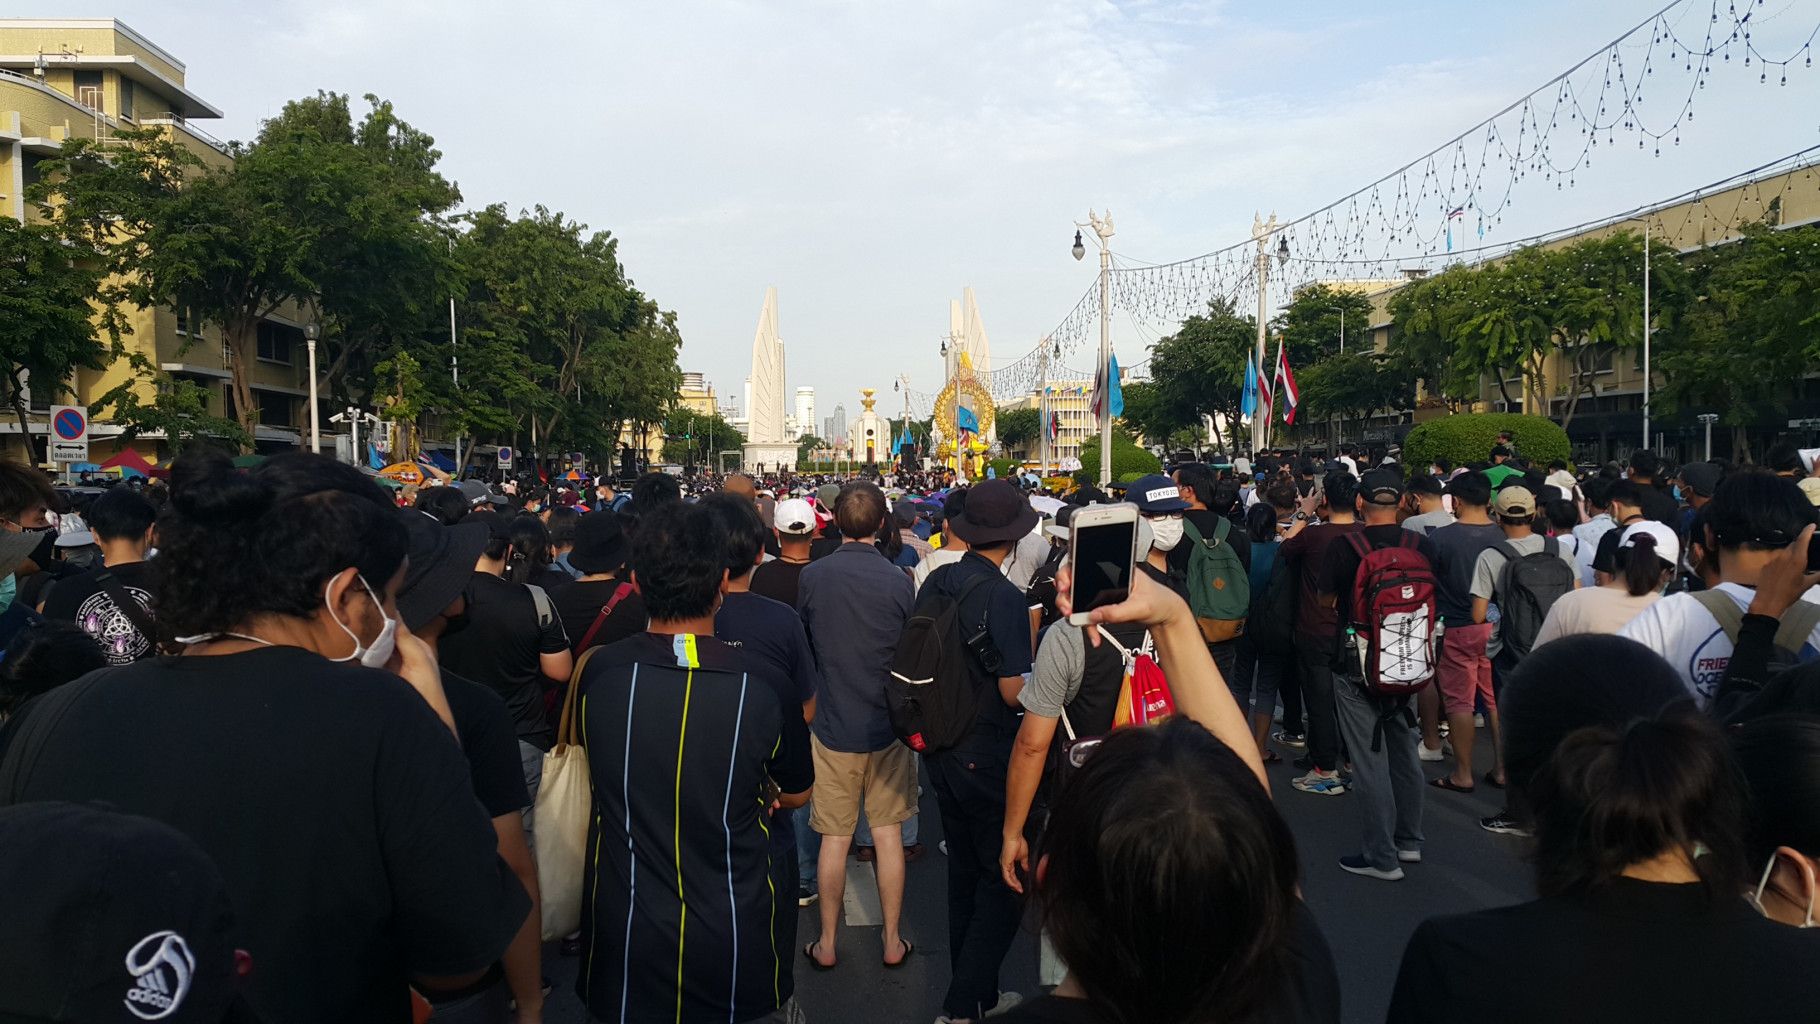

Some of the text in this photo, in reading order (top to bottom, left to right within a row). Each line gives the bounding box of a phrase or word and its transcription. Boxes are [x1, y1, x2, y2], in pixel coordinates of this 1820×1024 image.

[1407, 663, 1413, 671] IS
[1698, 657, 1728, 671] FRIE
[1698, 672, 1723, 684] OCE
[127, 988, 172, 1010] adidas
